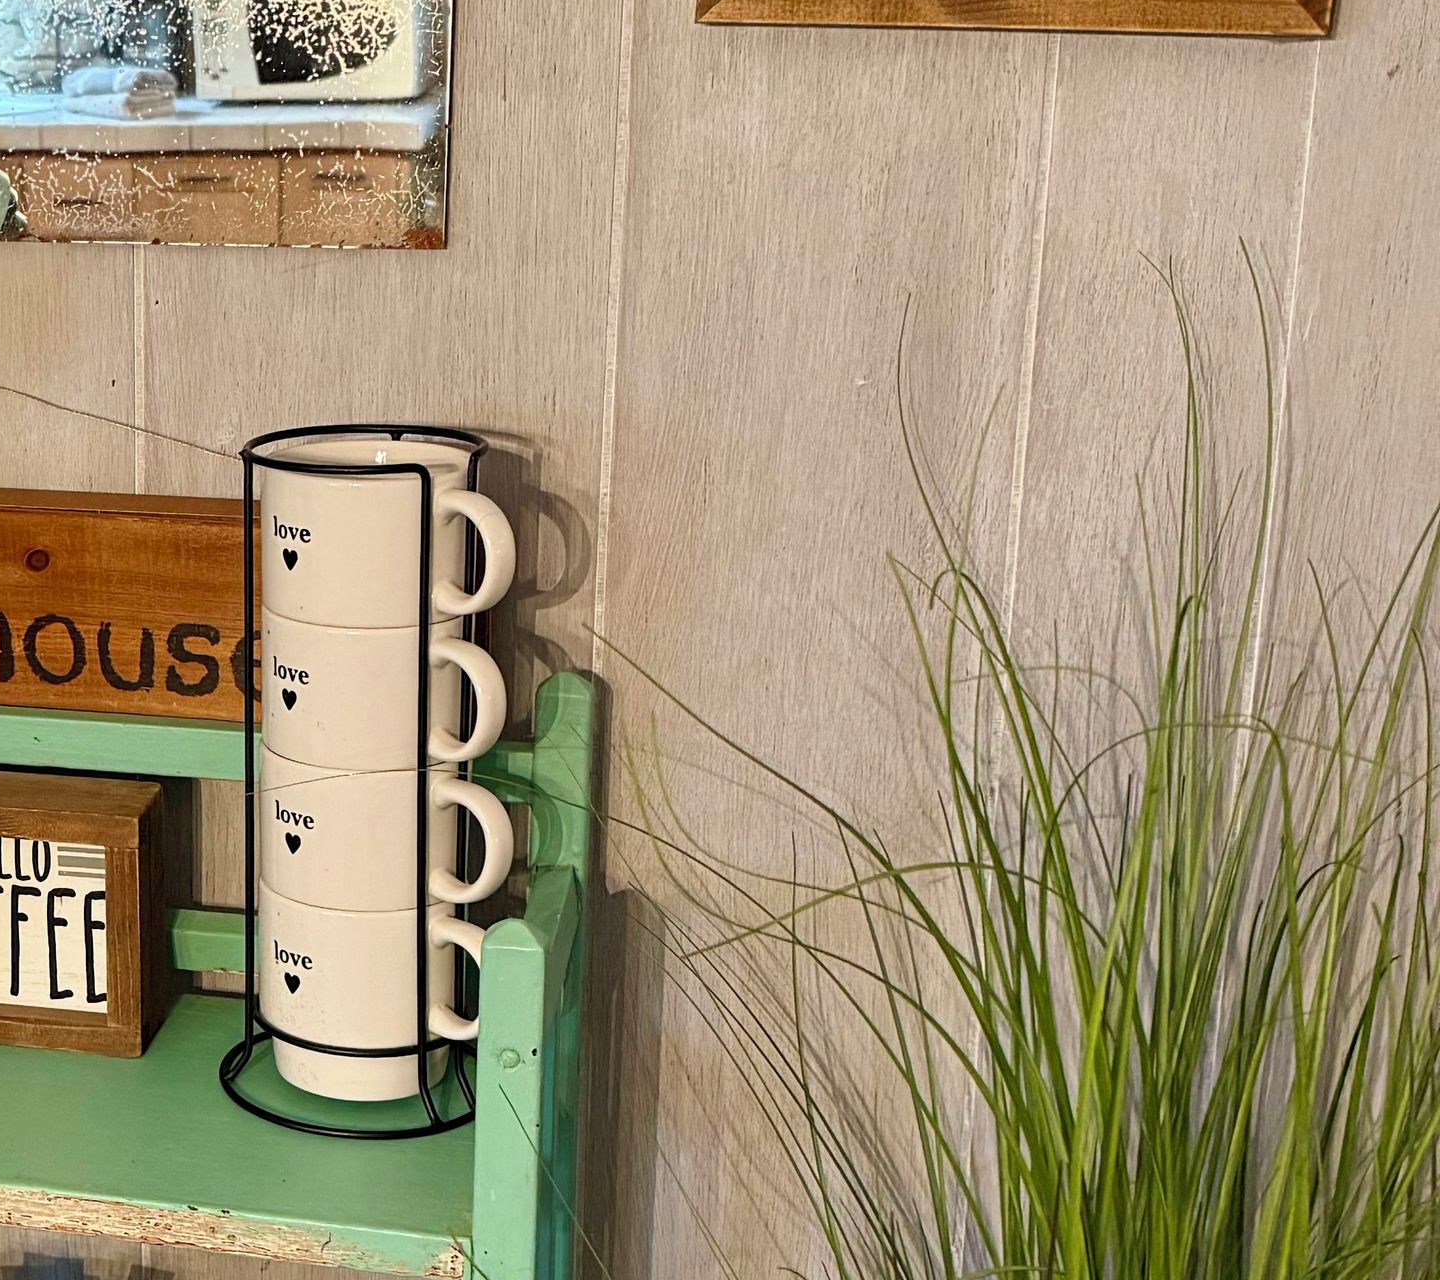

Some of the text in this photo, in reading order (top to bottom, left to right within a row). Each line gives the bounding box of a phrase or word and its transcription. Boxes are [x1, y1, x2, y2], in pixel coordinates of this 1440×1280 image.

[273, 515, 312, 544] love
[273, 656, 310, 685] love
[275, 800, 315, 830] love
[274, 940, 313, 970] love
